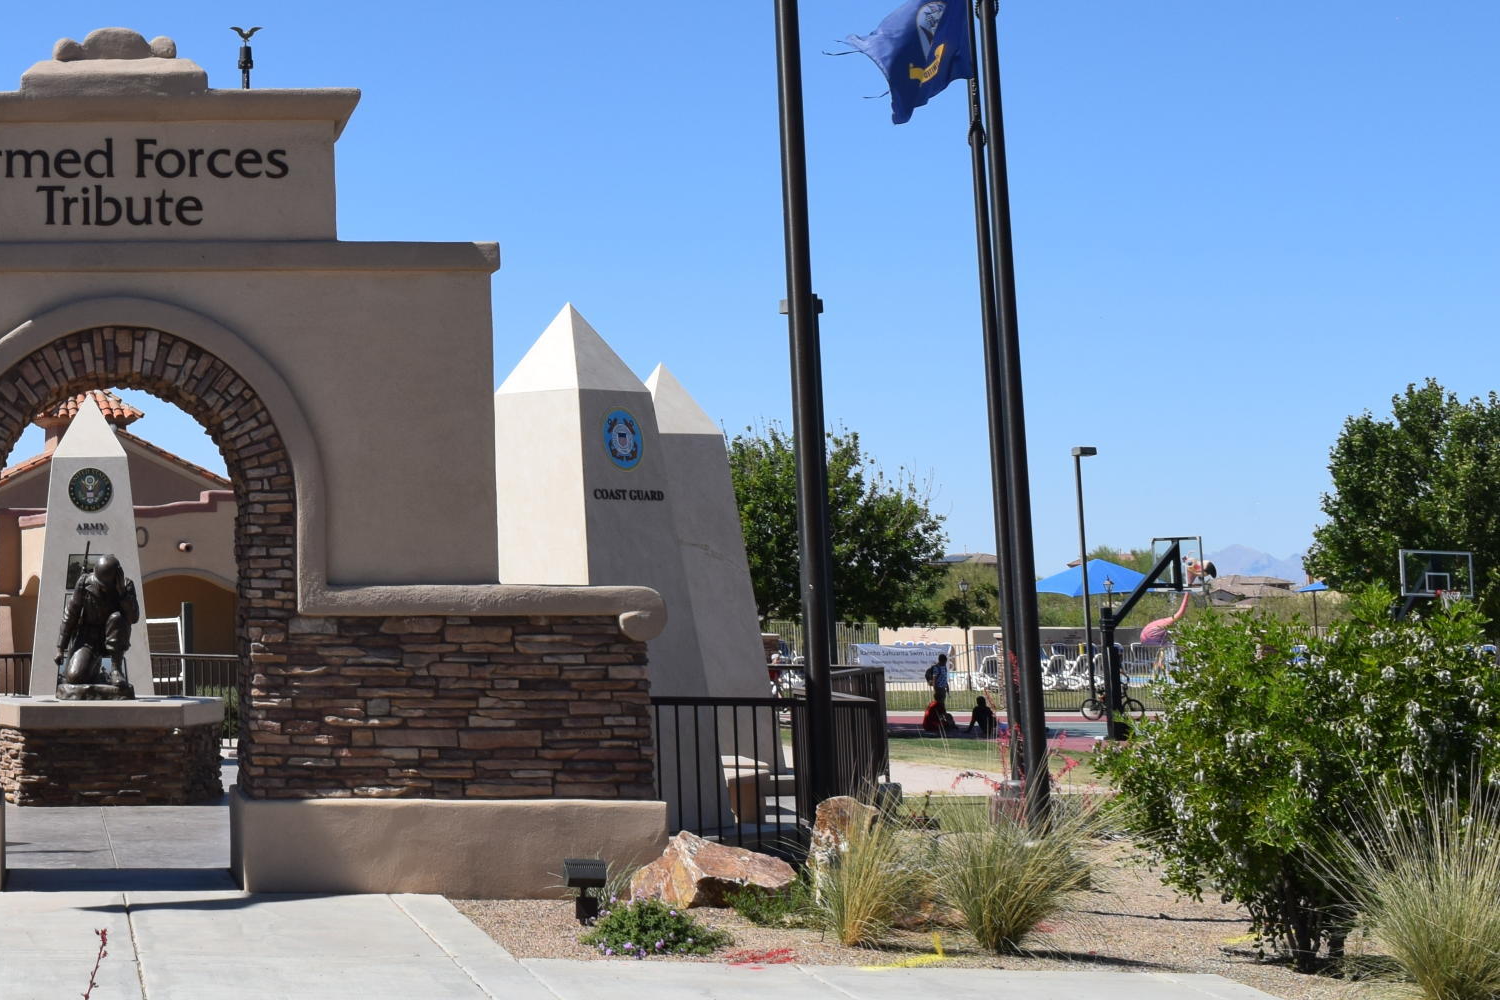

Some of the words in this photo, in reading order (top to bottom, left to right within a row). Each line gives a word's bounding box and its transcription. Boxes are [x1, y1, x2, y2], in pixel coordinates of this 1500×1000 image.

[135, 138, 290, 180] Forces
[36, 184, 204, 227] Tribute
[593, 488, 628, 501] COAST
[628, 489, 665, 502] GUARD
[76, 522, 106, 531] ARMY
